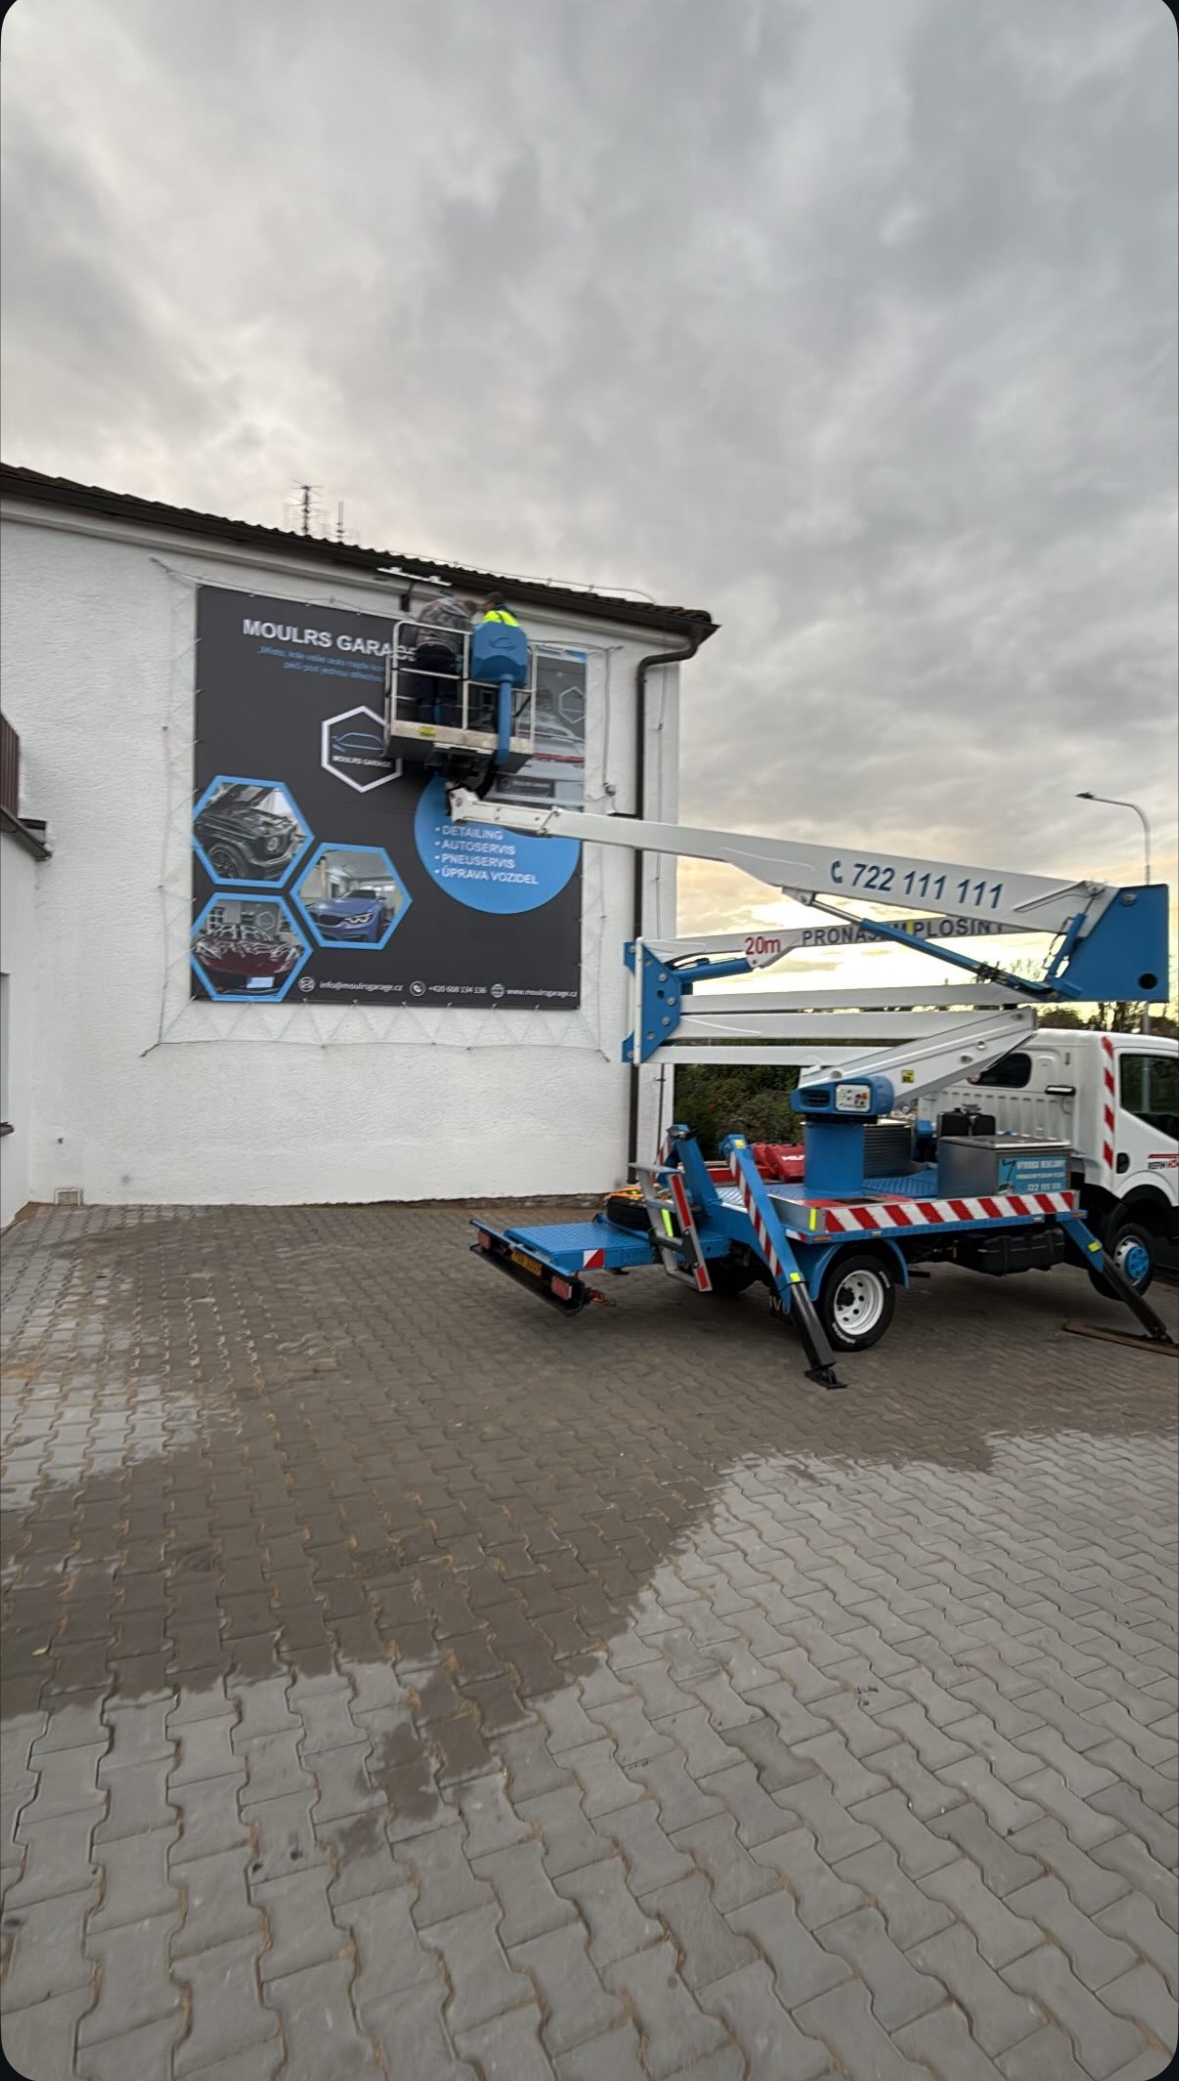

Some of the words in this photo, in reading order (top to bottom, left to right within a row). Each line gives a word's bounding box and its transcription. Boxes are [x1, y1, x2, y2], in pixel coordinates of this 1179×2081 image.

[243, 619, 332, 647] MOULRS
[441, 825, 503, 840] DETAILING
[441, 839, 516, 855] AUTOSERVIS
[441, 853, 516, 869] PNEUSERVIS
[441, 865, 488, 880] ÚPRAVA
[489, 872, 539, 885] VOZIDEL
[852, 863, 896, 892] 722
[903, 870, 947, 900] 111
[957, 878, 1003, 909] 111
[745, 936, 781, 955] 20m
